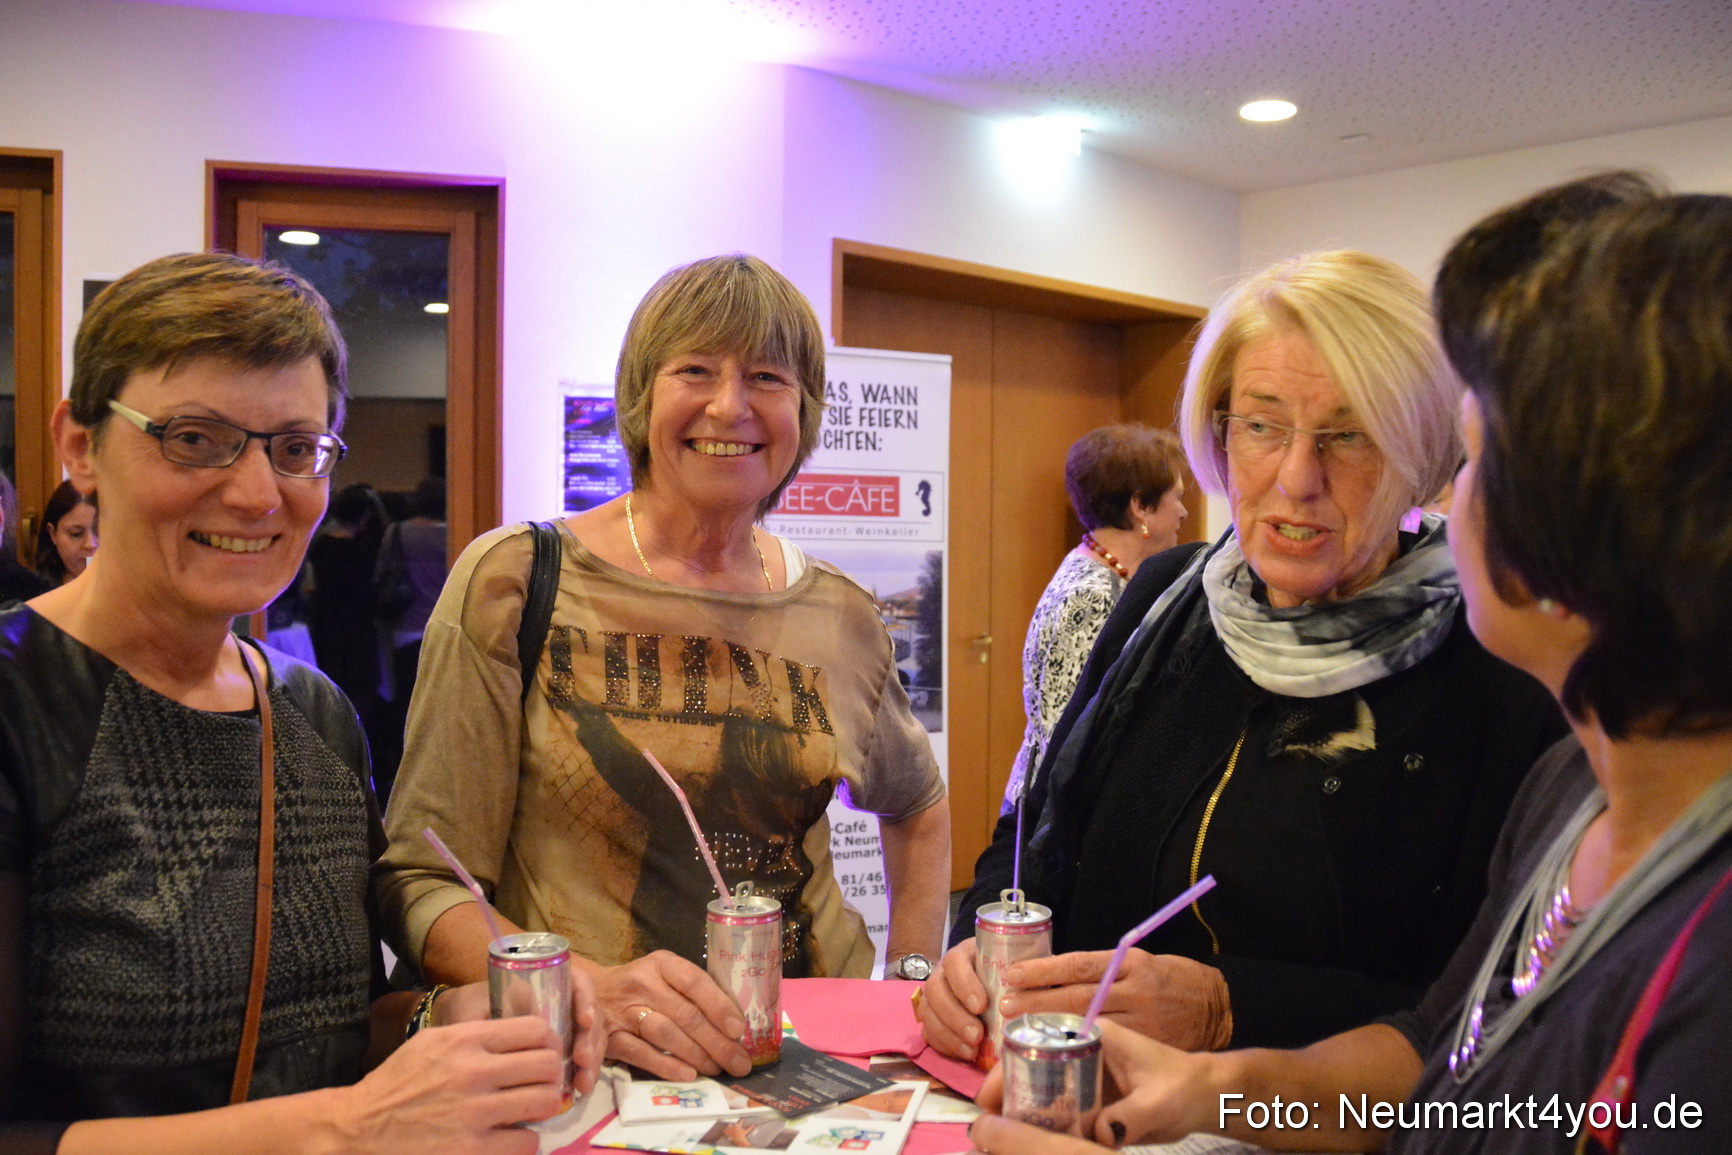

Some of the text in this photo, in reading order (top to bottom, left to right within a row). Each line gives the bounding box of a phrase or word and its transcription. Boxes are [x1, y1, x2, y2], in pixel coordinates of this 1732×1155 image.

[825, 380, 919, 406] AS, WANN
[827, 405, 919, 430] SIE FEIERN
[823, 429, 883, 451] CHTEN:
[548, 624, 836, 736] THINK
[611, 710, 651, 722] WHERE
[656, 714, 671, 723] TO
[672, 715, 698, 726] FIND
[831, 820, 867, 835] -Café
[845, 836, 880, 848] Neum
[831, 847, 883, 861] eumark
[719, 949, 746, 963] Pink
[982, 955, 1008, 972] Pnk
[741, 966, 766, 978] 2Go
